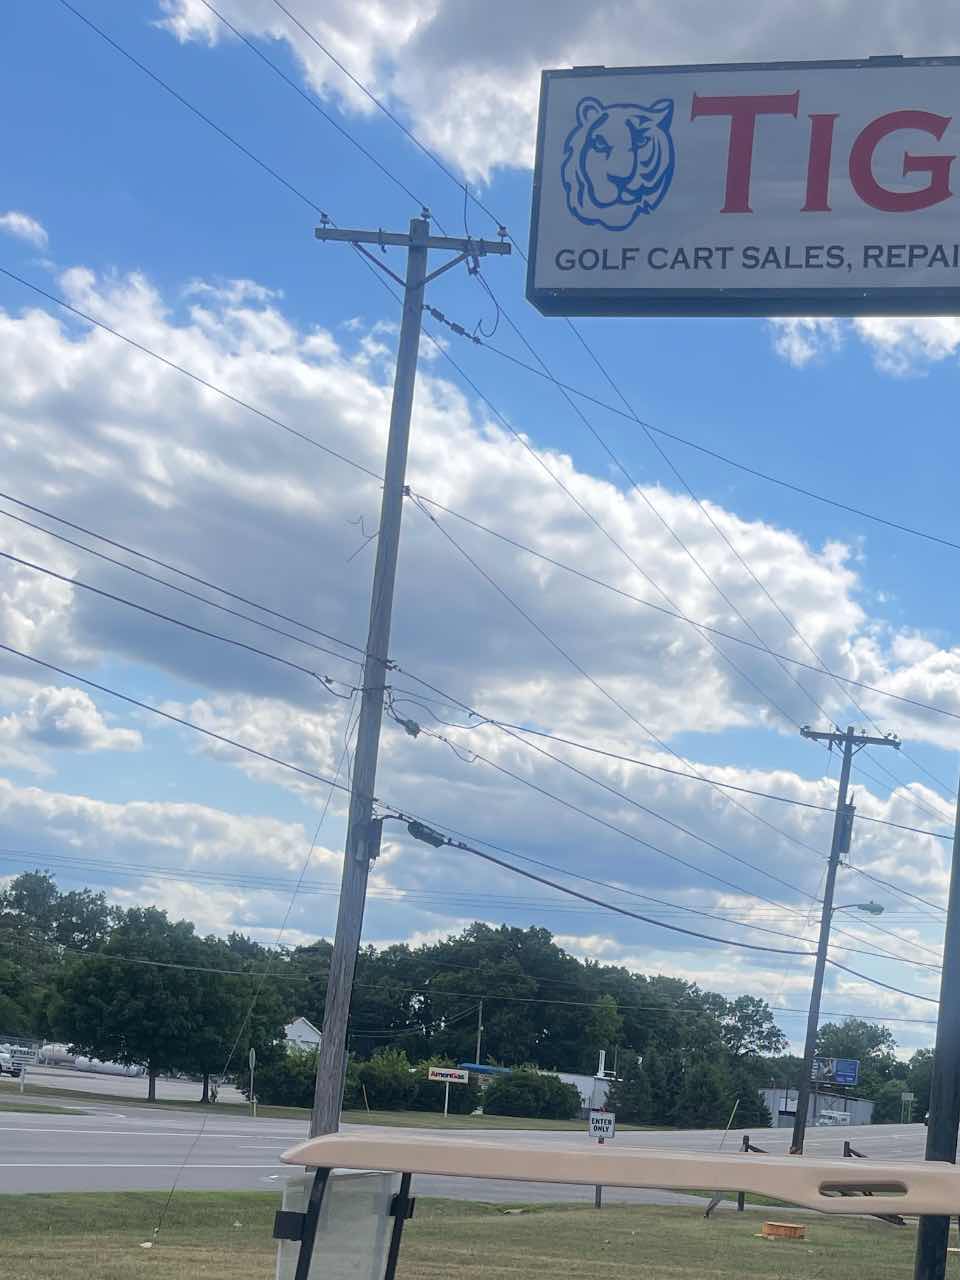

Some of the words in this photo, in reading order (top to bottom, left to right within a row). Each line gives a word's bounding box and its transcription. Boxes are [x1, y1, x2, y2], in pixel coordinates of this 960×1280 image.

[555, 247, 640, 271] GOLF
[647, 247, 733, 271] CART
[742, 245, 852, 272] SALES,
[592, 1117, 613, 1125] ENTER
